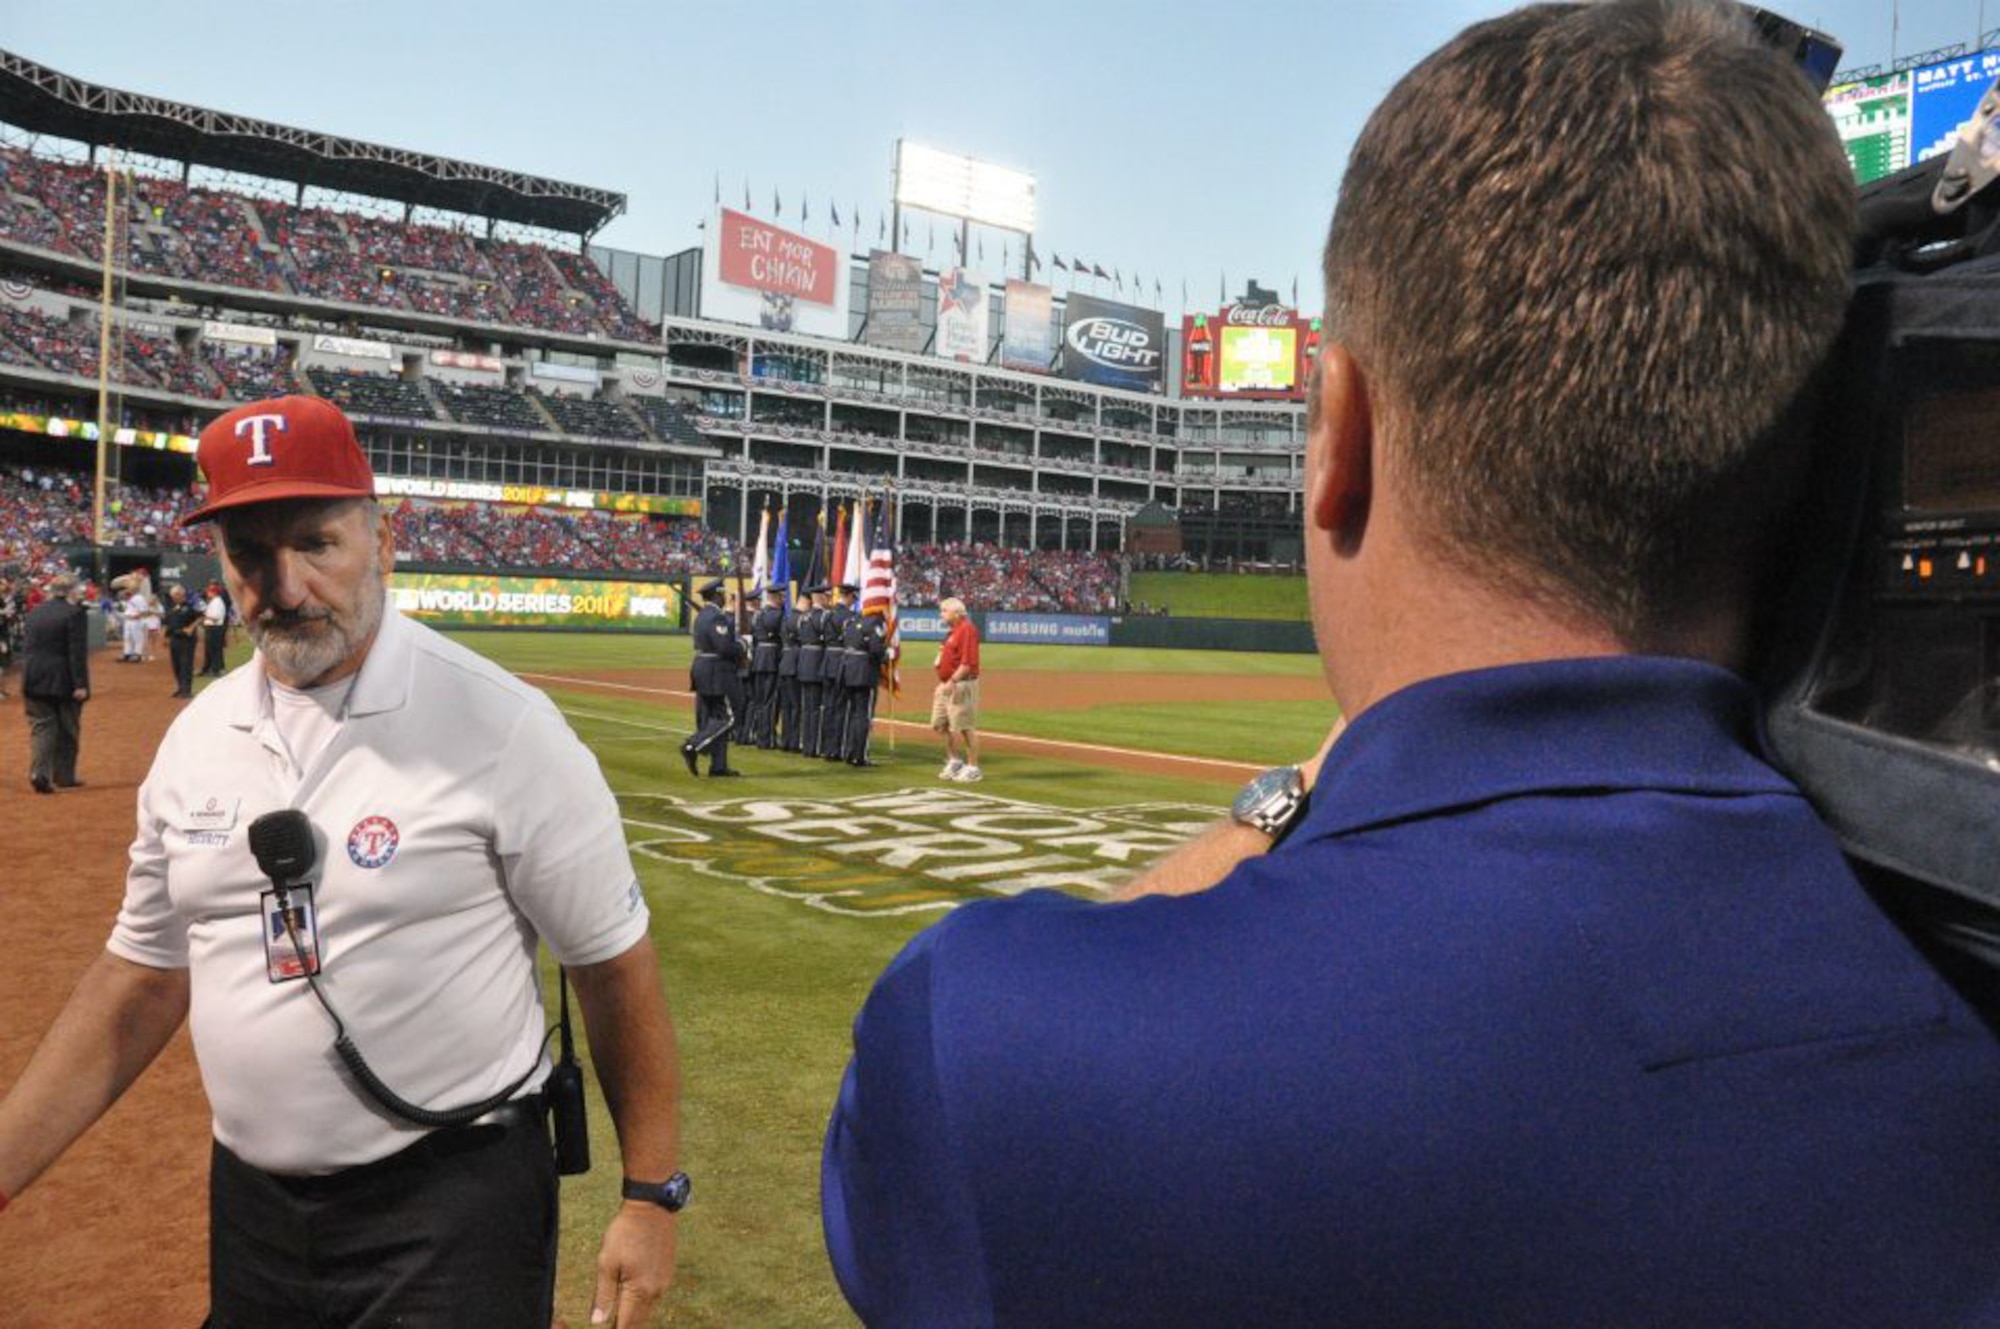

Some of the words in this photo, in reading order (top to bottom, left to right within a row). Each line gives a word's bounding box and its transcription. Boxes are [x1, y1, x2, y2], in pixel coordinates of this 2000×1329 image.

[779, 237, 813, 268] MOR
[751, 254, 817, 292] CHIKIN
[1090, 322, 1149, 347] BUD
[1076, 336, 1160, 366] LIGHT
[234, 413, 289, 467] T
[416, 589, 495, 612] WORLD
[496, 592, 572, 614] SERIES
[572, 595, 609, 613] 2011
[899, 618, 950, 632] GEIC
[988, 621, 1059, 636] SAMSUNG
[1062, 624, 1106, 637] mobile
